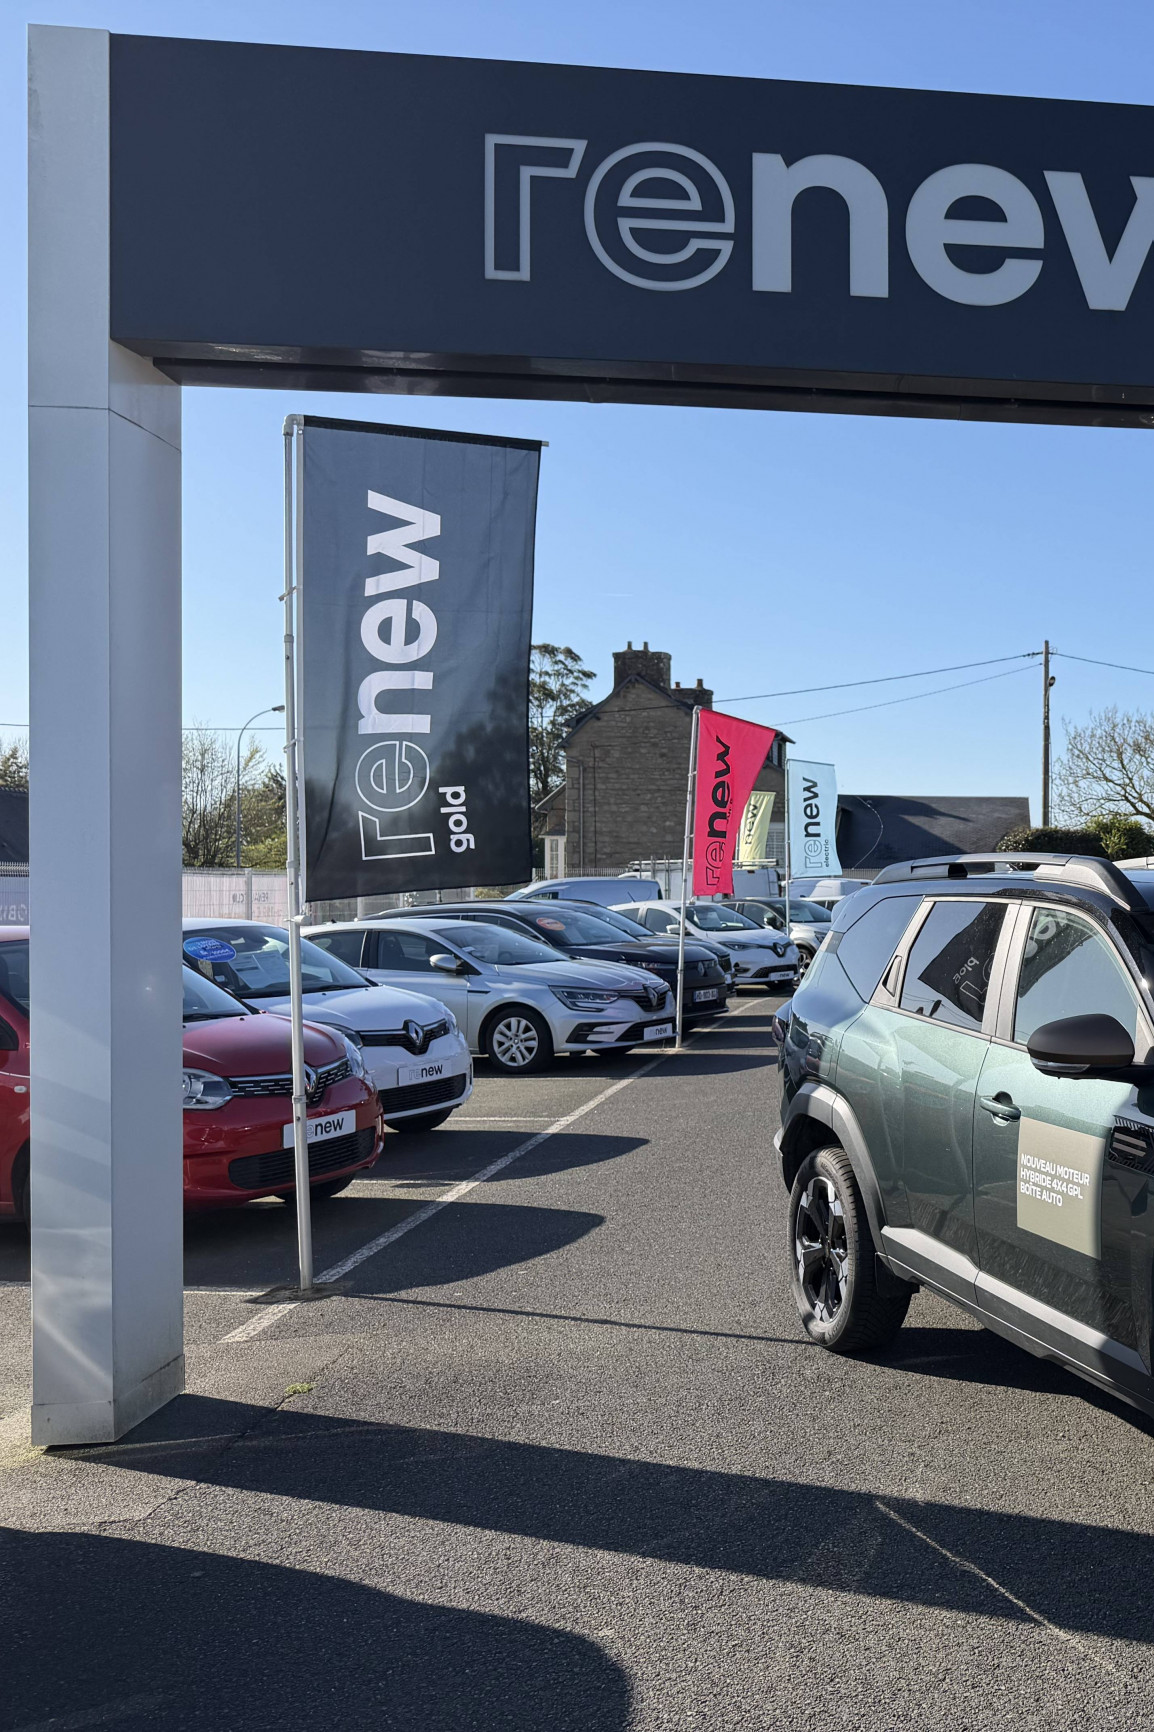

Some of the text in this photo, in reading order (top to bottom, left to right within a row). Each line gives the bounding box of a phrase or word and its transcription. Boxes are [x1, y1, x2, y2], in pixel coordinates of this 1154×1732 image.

[355, 489, 441, 861] renew
[439, 785, 475, 853] gold
[705, 735, 732, 887] renew
[802, 776, 823, 869] renew
[307, 1117, 345, 1139] enew
[1020, 1167, 1084, 1199] HYBRIDE 4X4 GPL
[1020, 1181, 1063, 1206] BOÎTE AUTO
[1021, 1153, 1090, 1186] NOUVEAU MOTEUR
